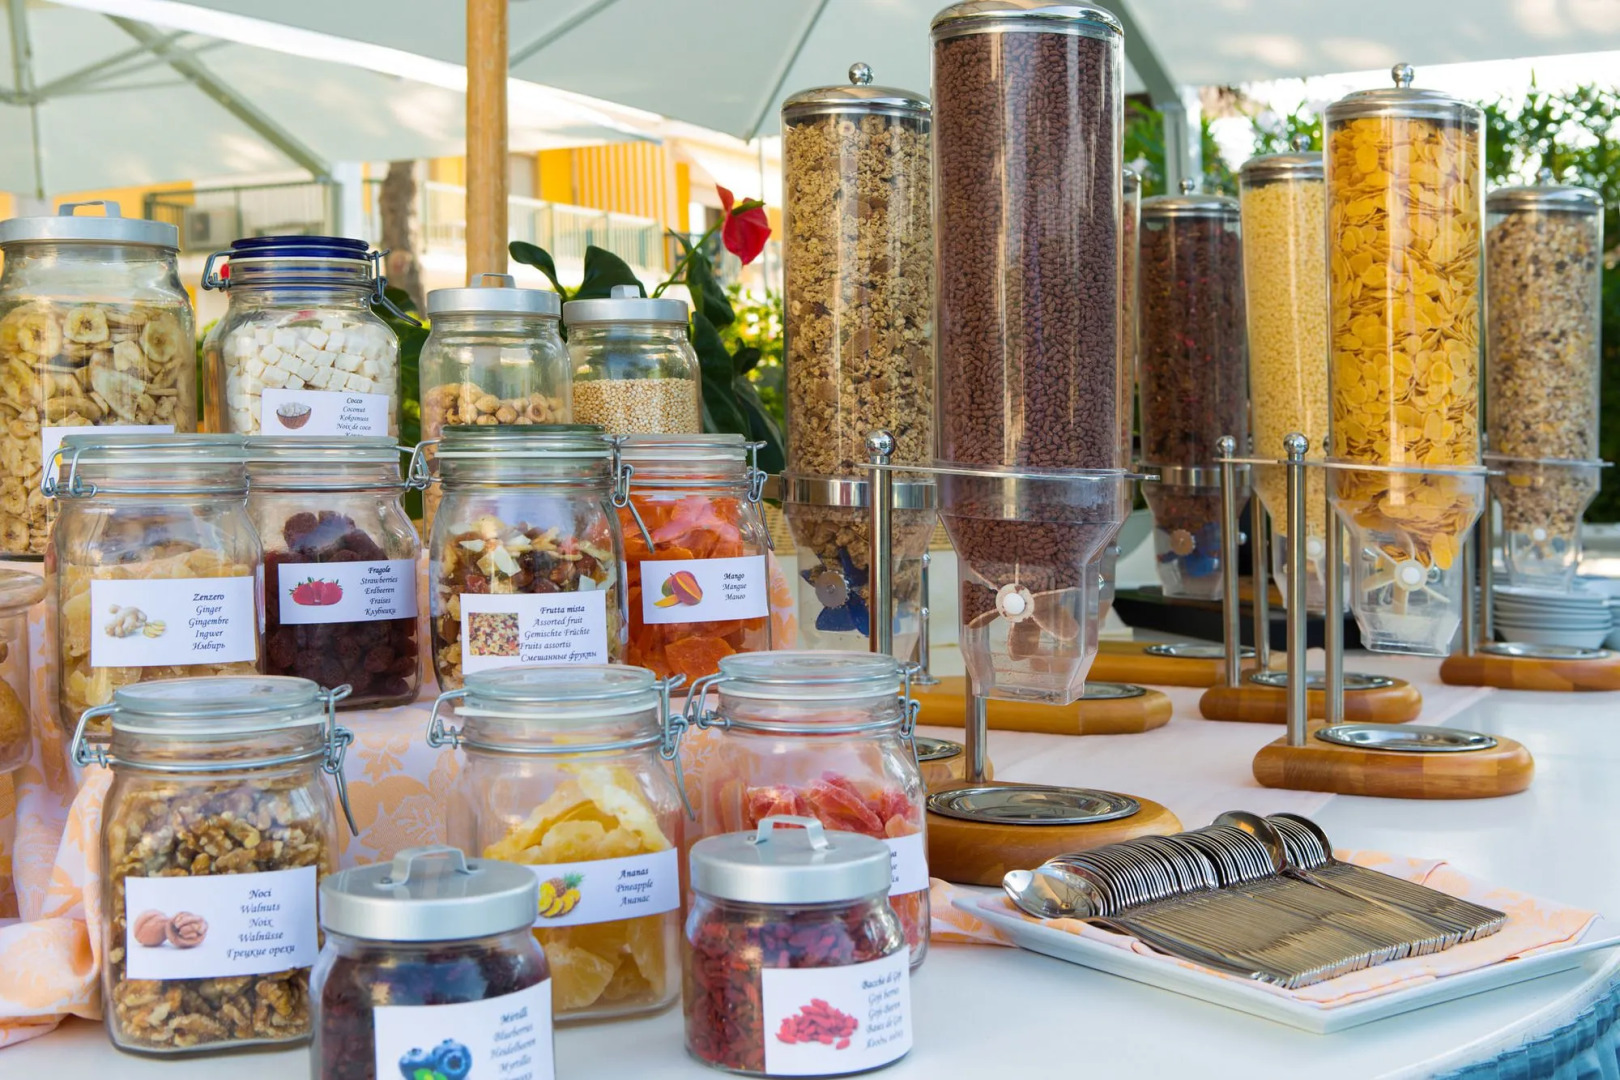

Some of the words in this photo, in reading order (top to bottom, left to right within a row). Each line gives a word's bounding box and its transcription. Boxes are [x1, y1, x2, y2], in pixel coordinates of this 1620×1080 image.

[360, 576, 398, 585] Strawberries
[724, 573, 745, 581] Mango
[364, 586, 395, 594] Erdbeeren
[192, 593, 224, 601] Zenzero
[196, 605, 222, 616] Ginger
[188, 616, 229, 628] Gingembre
[532, 616, 566, 627] Assorted
[565, 616, 583, 628] fruit
[195, 630, 224, 640] Ingwer
[524, 629, 562, 640] Gemischte
[564, 627, 590, 637] Früchte
[192, 640, 226, 652] Имбирь
[618, 868, 648, 880] Ananas
[249, 888, 272, 899] Noci
[240, 902, 280, 914] Walnuts
[249, 917, 274, 928] Noix
[239, 931, 284, 942] Walnüsse
